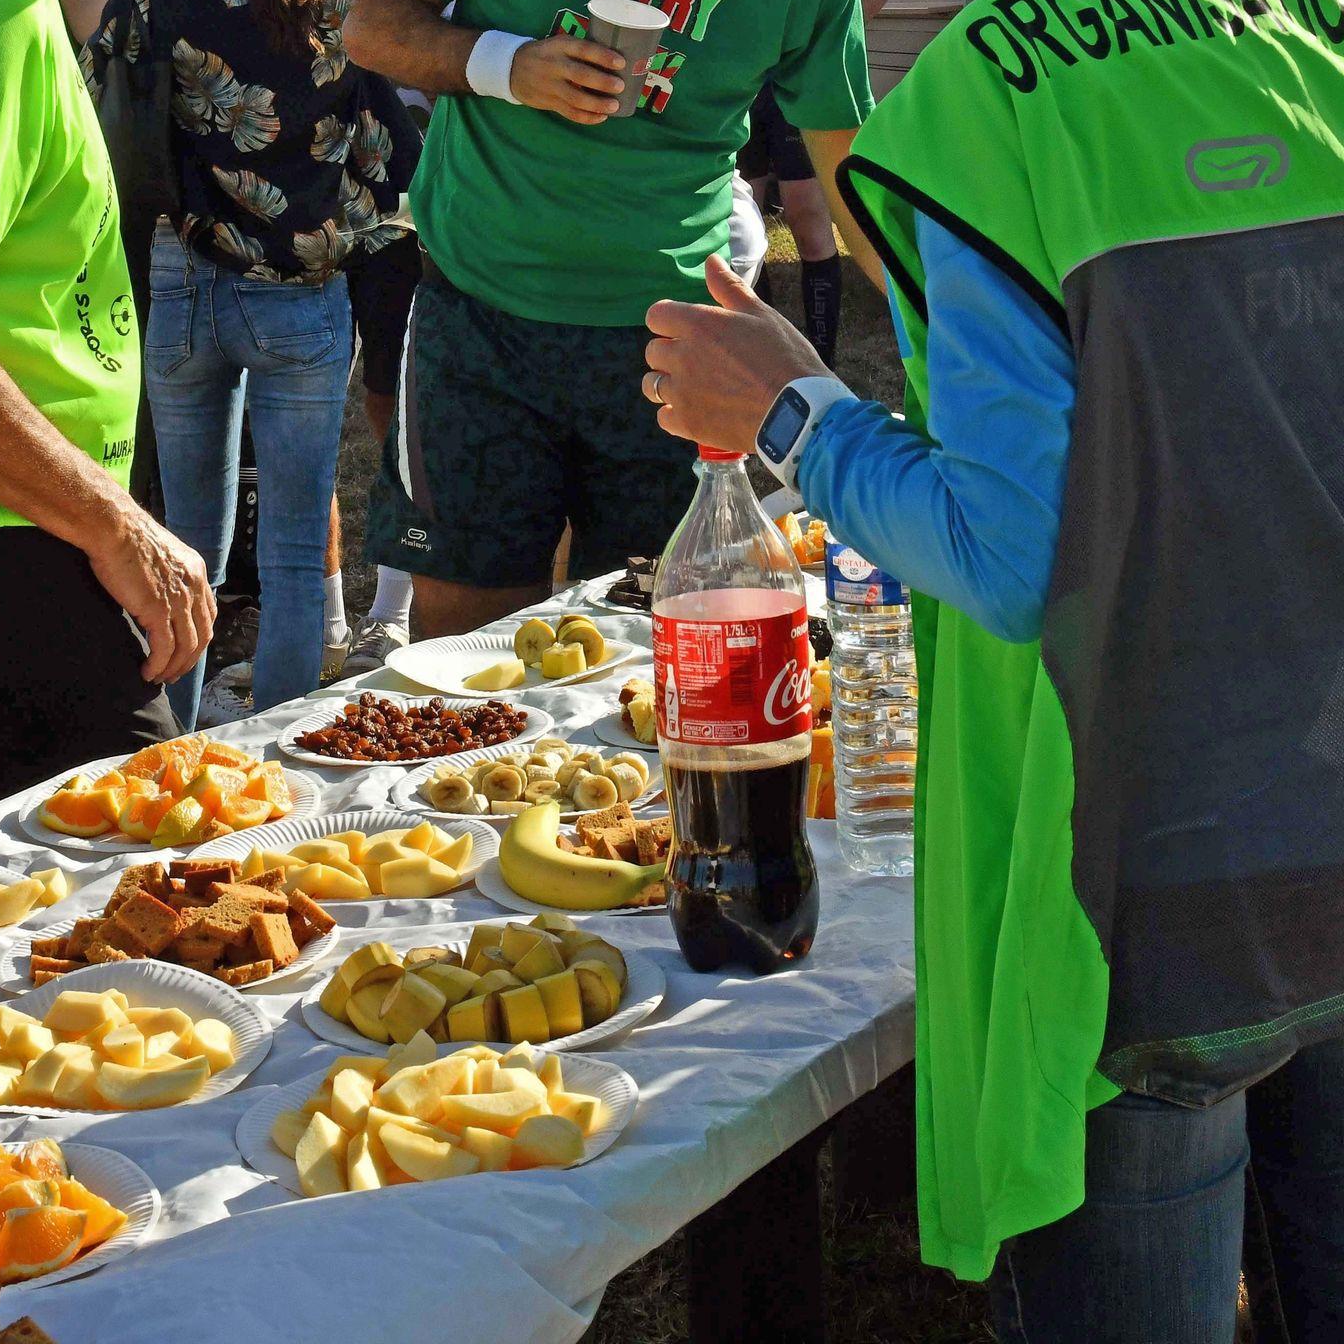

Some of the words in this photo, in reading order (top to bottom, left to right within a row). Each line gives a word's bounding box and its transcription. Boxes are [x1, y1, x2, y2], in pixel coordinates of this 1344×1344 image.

[75, 292, 123, 373] SPORTS
[400, 537, 432, 552] Kalenji
[724, 624, 745, 636] 1.75L
[667, 691, 675, 706] 7
